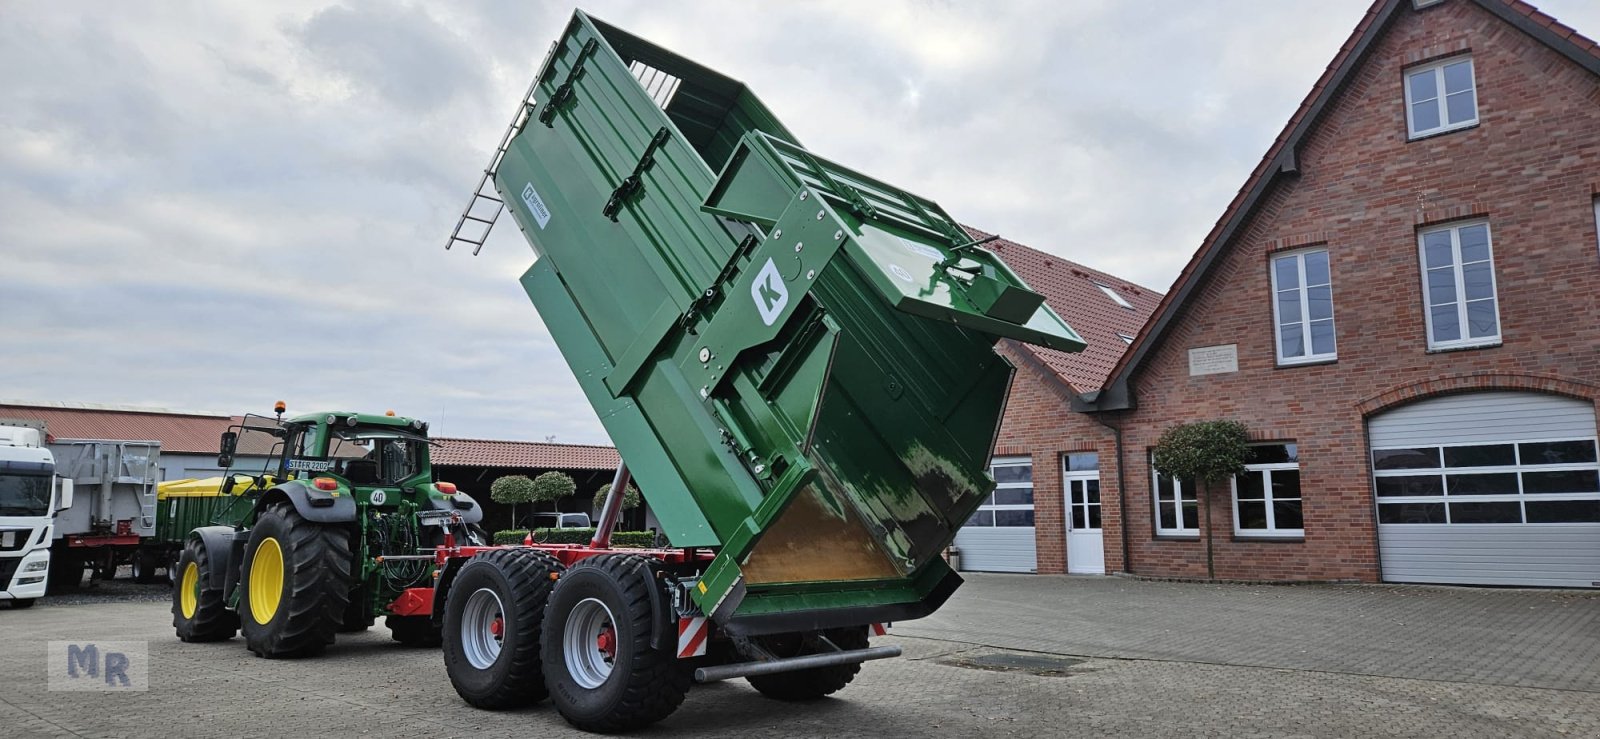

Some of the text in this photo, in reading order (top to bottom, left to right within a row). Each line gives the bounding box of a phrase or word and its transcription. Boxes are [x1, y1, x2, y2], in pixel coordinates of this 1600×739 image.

[758, 272, 782, 312] K
[311, 461, 328, 470] 2202
[373, 491, 384, 502] 40
